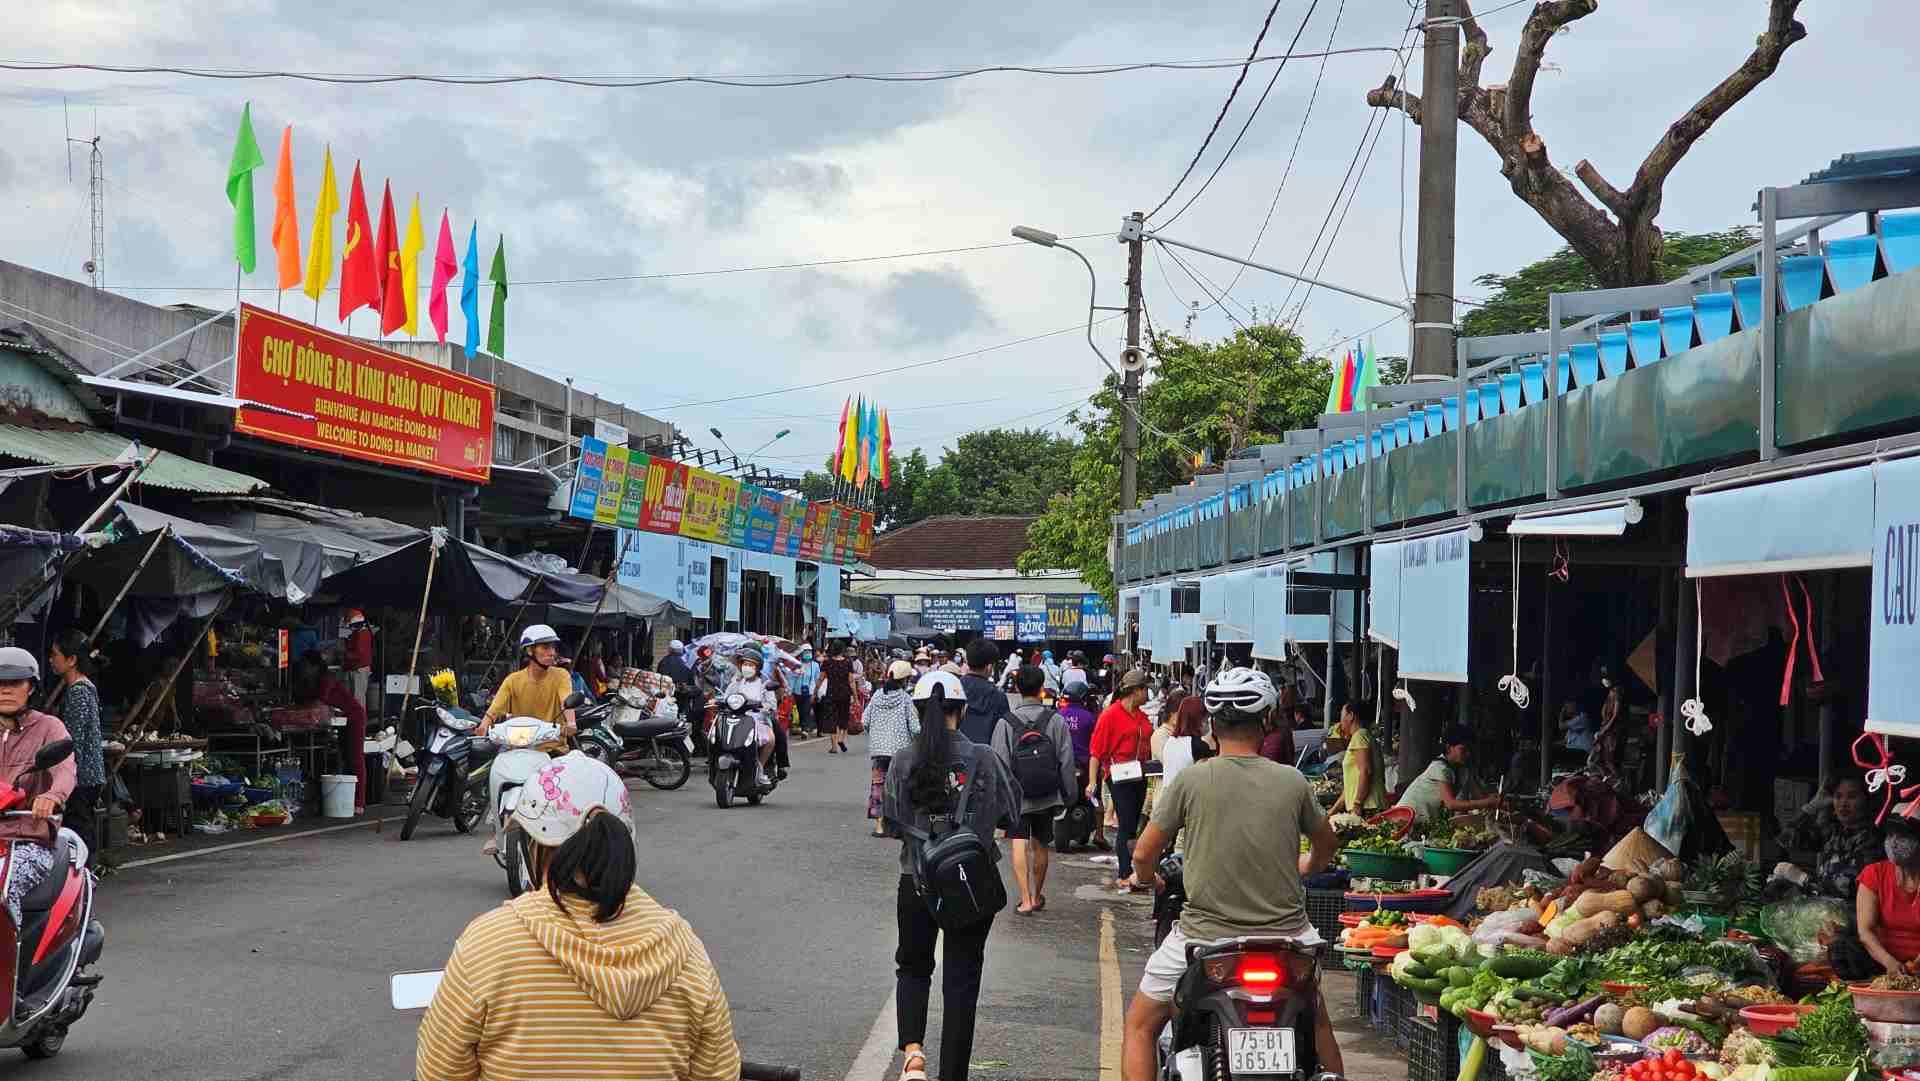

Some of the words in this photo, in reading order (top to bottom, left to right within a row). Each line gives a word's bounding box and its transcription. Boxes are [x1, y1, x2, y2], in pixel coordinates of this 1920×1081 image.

[263, 336, 294, 386] CHỢ
[296, 341, 333, 389] ĐÔNG
[336, 358, 353, 395] BA
[356, 360, 384, 403] KÍNH
[387, 371, 417, 412] CHÀO
[421, 381, 441, 418] QUÝ
[443, 387, 481, 429] KHÁCH!
[315, 398, 358, 421] BIENVENUE
[360, 407, 370, 425] AU
[372, 412, 403, 433] MARCHÉ
[405, 420, 426, 437] DONG
[317, 422, 356, 444] WELCOME
[359, 431, 369, 447] TO
[370, 434, 393, 452] DONG
[395, 440, 404, 454] BA
[1047, 605, 1079, 627] XUÂN
[1239, 1031, 1283, 1050] 75-B1
[1234, 1052, 1290, 1070] 365.41
